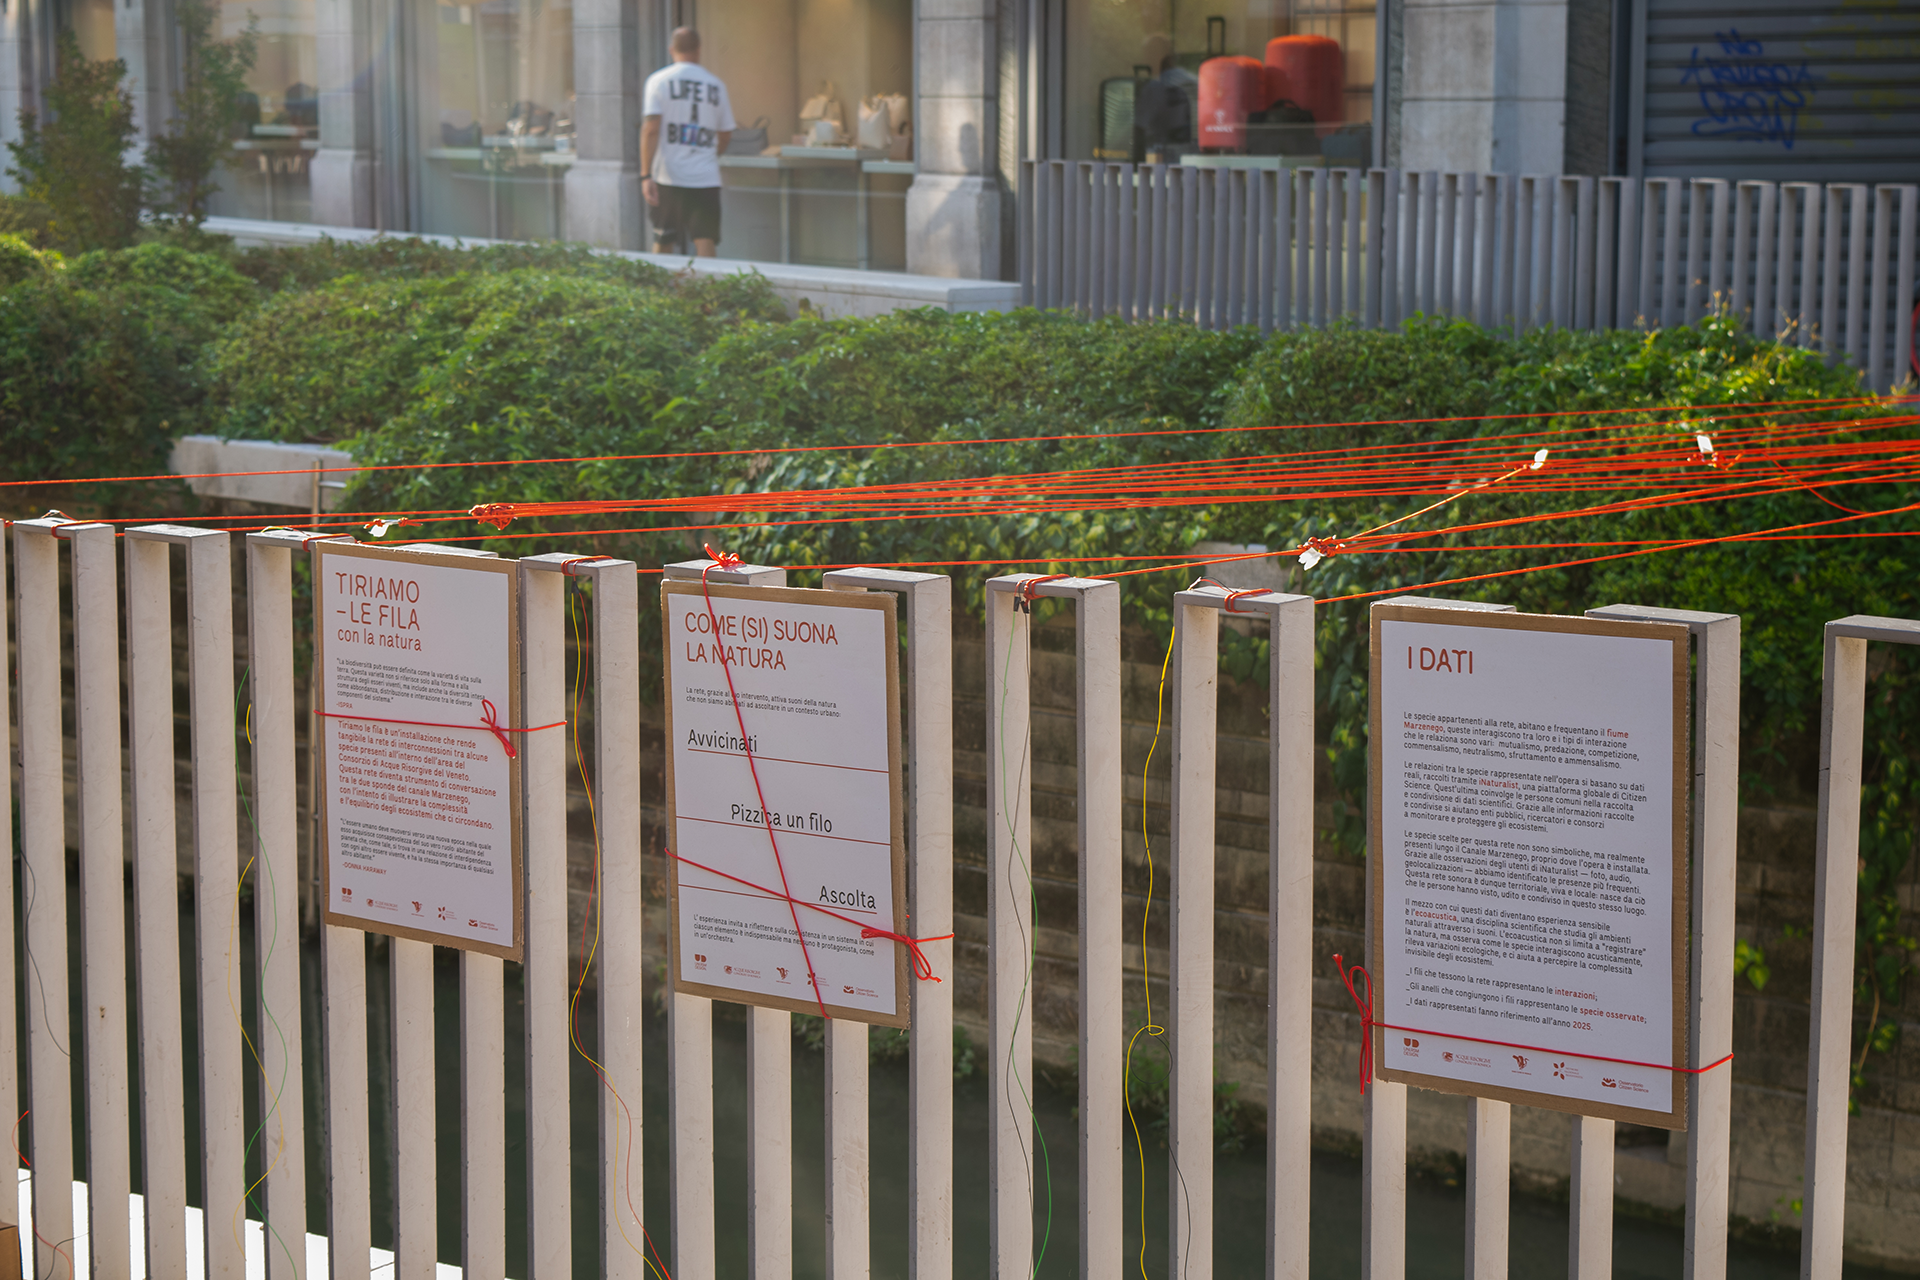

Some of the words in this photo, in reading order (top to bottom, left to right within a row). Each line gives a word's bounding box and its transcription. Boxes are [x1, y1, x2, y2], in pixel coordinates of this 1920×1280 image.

[669, 79, 703, 102] LIFE
[708, 84, 719, 107] IS
[690, 103, 699, 123] A
[335, 572, 419, 602] TIRIAMO
[378, 604, 420, 630] FILA
[685, 611, 736, 636] COME
[741, 615, 768, 643] (SI)
[773, 619, 837, 645] SUONA
[337, 628, 359, 642] con
[363, 627, 374, 644] la
[379, 633, 421, 650] natura
[686, 641, 707, 663] LA
[712, 643, 785, 670] NATURA
[1408, 646, 1412, 669] I
[1419, 646, 1472, 674] DATI
[693, 688, 706, 696] rete,
[740, 692, 770, 702] intervento,
[770, 695, 787, 703] attiva
[707, 697, 723, 705] siamo
[754, 702, 779, 711] ascoltare
[794, 707, 818, 715] contesto
[338, 719, 363, 731] Tiriamo
[364, 723, 370, 732] le
[372, 724, 382, 734] fila
[384, 727, 388, 735] è
[390, 728, 441, 743] un'installazione
[442, 736, 455, 745] che
[456, 739, 476, 748] rende
[1403, 711, 1412, 719] Le
[1414, 713, 1435, 721] specie
[1437, 715, 1482, 725] appartenenti
[1484, 718, 1497, 727] alla
[1499, 720, 1515, 730] rete,
[1518, 721, 1545, 731] abitano
[1553, 724, 1598, 736] frequentano
[1600, 728, 1604, 736] il
[1607, 728, 1628, 738] fiume
[1403, 721, 1445, 733] Marzenego,
[1447, 726, 1470, 734] queste
[1472, 727, 1521, 739] interagiscono
[1522, 732, 1533, 740] tra
[1535, 732, 1550, 742] loro
[1558, 734, 1560, 742] i
[1562, 735, 1574, 745] tipi
[1576, 736, 1583, 744] di
[1584, 737, 1626, 748] interazione
[338, 731, 365, 743] tangibile
[367, 735, 373, 744] la
[375, 738, 389, 746] rete
[390, 738, 396, 747] di
[398, 739, 452, 756] interconnessioni
[453, 749, 464, 758] tra
[466, 750, 488, 762] alcune
[688, 729, 756, 752] Avvicinati
[1403, 731, 1416, 739] che
[1417, 732, 1424, 740] le
[1426, 733, 1457, 743] relaziona
[1459, 737, 1477, 745] sono
[1478, 738, 1494, 746] vari:
[1498, 741, 1542, 752] mutualismo,
[1544, 745, 1586, 756] predazione,
[1587, 749, 1639, 761] competizione,
[1403, 741, 1461, 754] commensalismo,
[1462, 747, 1506, 759] neutralismo,
[1509, 751, 1556, 762] sfruttamento
[1563, 757, 1621, 768] ammensalismo.
[338, 743, 358, 752] specie
[360, 746, 386, 756] presenti
[388, 750, 421, 762] all'interno
[423, 755, 453, 767] dell'area
[454, 760, 465, 769] del
[338, 752, 370, 765] Consorzio
[372, 757, 378, 766] di
[380, 759, 399, 770] Acque
[401, 762, 432, 775] Risorgive
[433, 768, 444, 777] del
[445, 769, 471, 781] Veneto.
[731, 803, 781, 826] Pizzica
[786, 815, 803, 829] un
[809, 812, 832, 832] filo
[819, 885, 875, 909] Ascolta
[693, 922, 713, 931] ciascun
[714, 925, 738, 935] elemento
[744, 929, 781, 942] indispensabile
[821, 942, 857, 955] protagonista,
[699, 915, 727, 925] esperienza
[728, 918, 743, 927] invita
[748, 922, 773, 932] riflettere
[774, 926, 787, 934] sulla
[821, 932, 826, 940] in
[836, 935, 857, 944] sistema
[858, 937, 864, 945] in
[865, 938, 874, 947] cui
[699, 932, 734, 943] un'orchestra.
[1414, 967, 1423, 975] fili
[1423, 969, 1436, 978] che
[1438, 971, 1465, 982] tessono
[1467, 974, 1473, 983] la
[1475, 977, 1490, 985] rete
[1492, 980, 1544, 993] rappresentano
[1546, 985, 1552, 994] le
[1554, 986, 1597, 1001] interazioni;
[1414, 997, 1427, 1006] dati
[1429, 1001, 1476, 1013] rappresentati
[1478, 1006, 1498, 1017] fanno
[1500, 1010, 1540, 1023] riferimento
[1541, 1016, 1570, 1027] all'anno
[1572, 1020, 1593, 1031] 2025.
[1421, 984, 1439, 993] anelli
[1440, 986, 1453, 995] che
[1454, 989, 1499, 1002] congiungono
[1501, 994, 1503, 1002] i
[1505, 995, 1514, 1004] fili
[1516, 998, 1569, 1012] rappresentano
[1570, 1004, 1577, 1013] le
[1580, 1007, 1603, 1016] specie
[1605, 1011, 1646, 1024] osservate;
